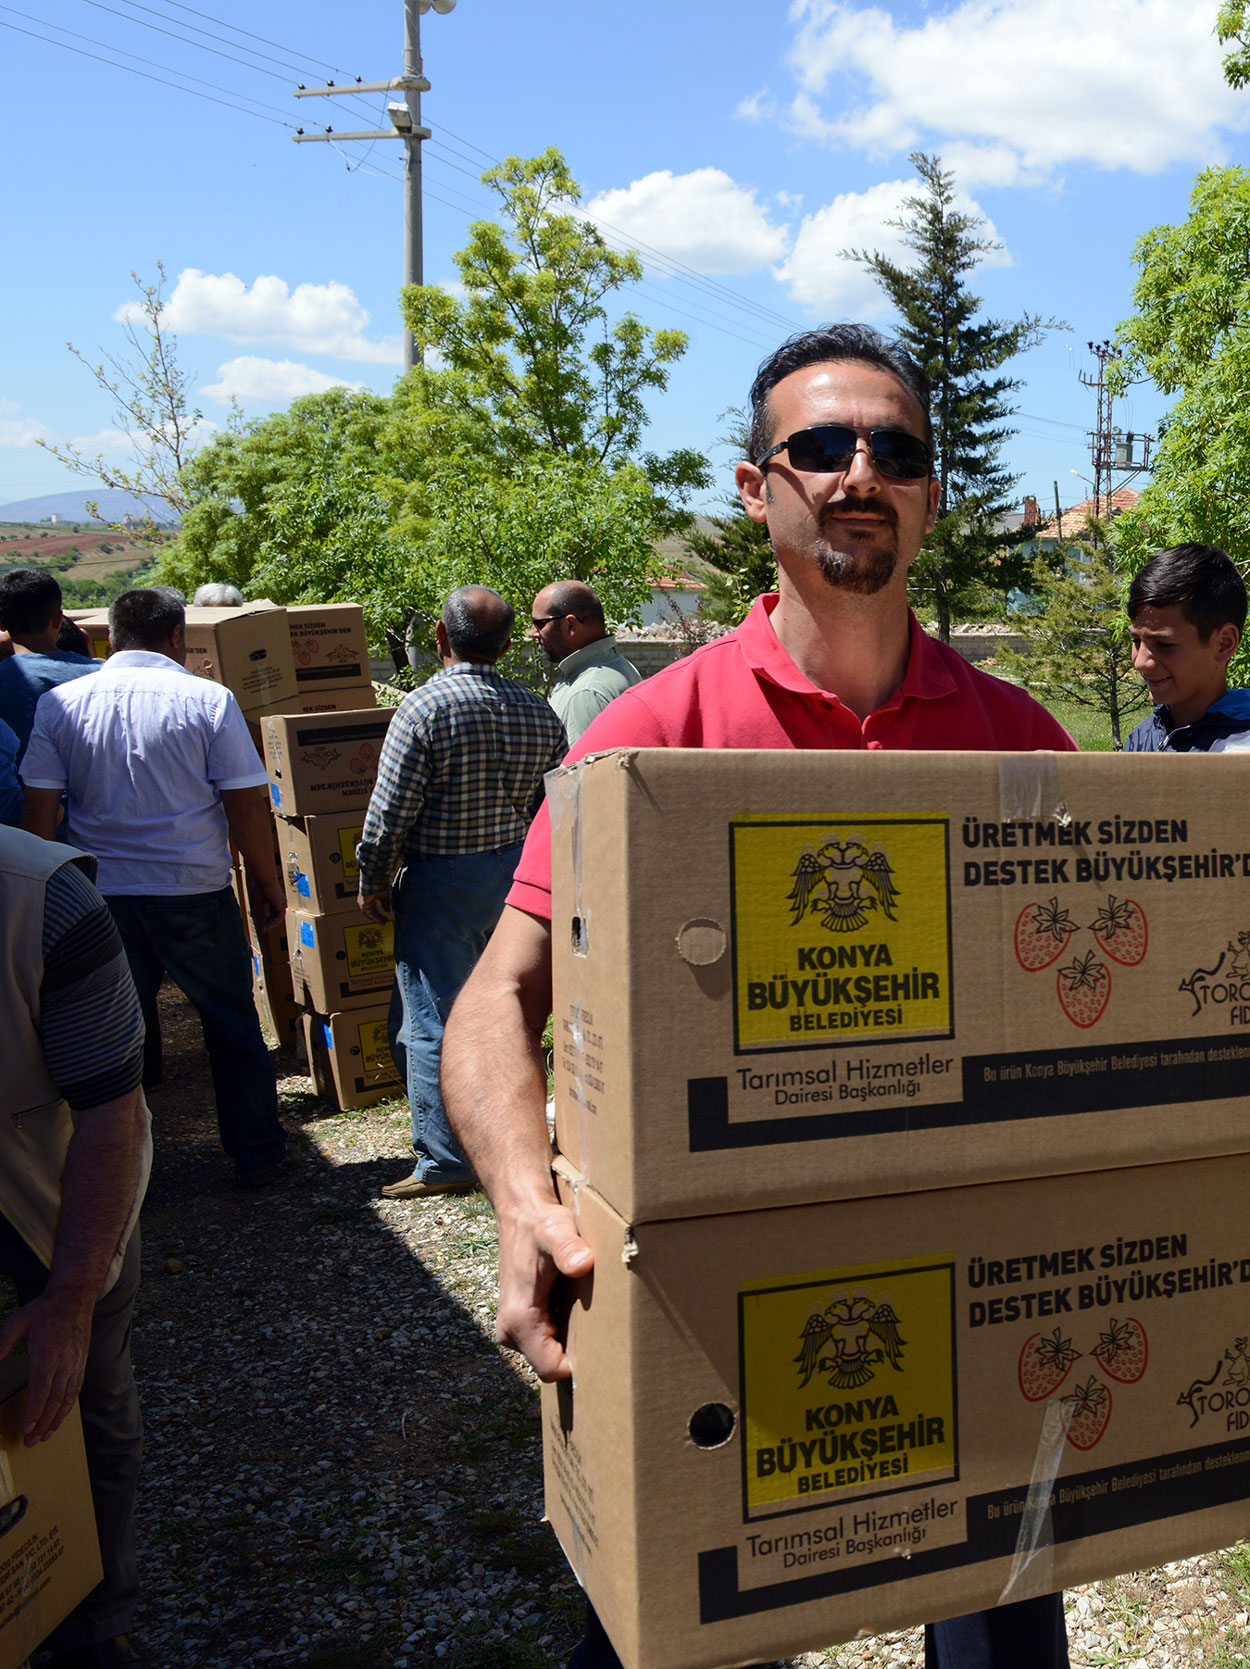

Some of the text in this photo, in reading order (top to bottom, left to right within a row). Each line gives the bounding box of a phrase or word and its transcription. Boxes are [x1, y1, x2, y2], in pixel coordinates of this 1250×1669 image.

[962, 815, 1188, 848] ÜRETMEK SİZDEN
[964, 859, 1069, 886] DESTEK
[798, 944, 893, 971] KONYA
[748, 967, 940, 1011] BÜYÜKŞEHİR
[790, 1004, 903, 1032] BELEDİYESİ
[736, 1053, 954, 1090] Tarımsal Hizmetler
[984, 1067, 997, 1082] Bu
[1000, 1065, 1022, 1080] ürün
[1025, 1063, 1054, 1080] Konya
[1057, 1057, 1108, 1077] Büyükşehir
[1111, 1052, 1158, 1071] Belediyesi
[775, 1079, 921, 1106] Dairesi Başkanlığı
[967, 1233, 1188, 1289] ÜRETMEK SİZDEN
[968, 1287, 1072, 1329] DESTEK
[805, 1394, 900, 1432] KONYA
[756, 1413, 945, 1478] BÜYÜKŞEHİR
[798, 1453, 909, 1494] BELEDİYESİ
[987, 1504, 1000, 1520] Bu
[1059, 1480, 1108, 1504] Büyükşehir
[1111, 1469, 1157, 1492] Belediyesi
[746, 1497, 958, 1558] Tarımsal Hizmetler
[783, 1526, 927, 1568] Dairesi Başkanlığı
